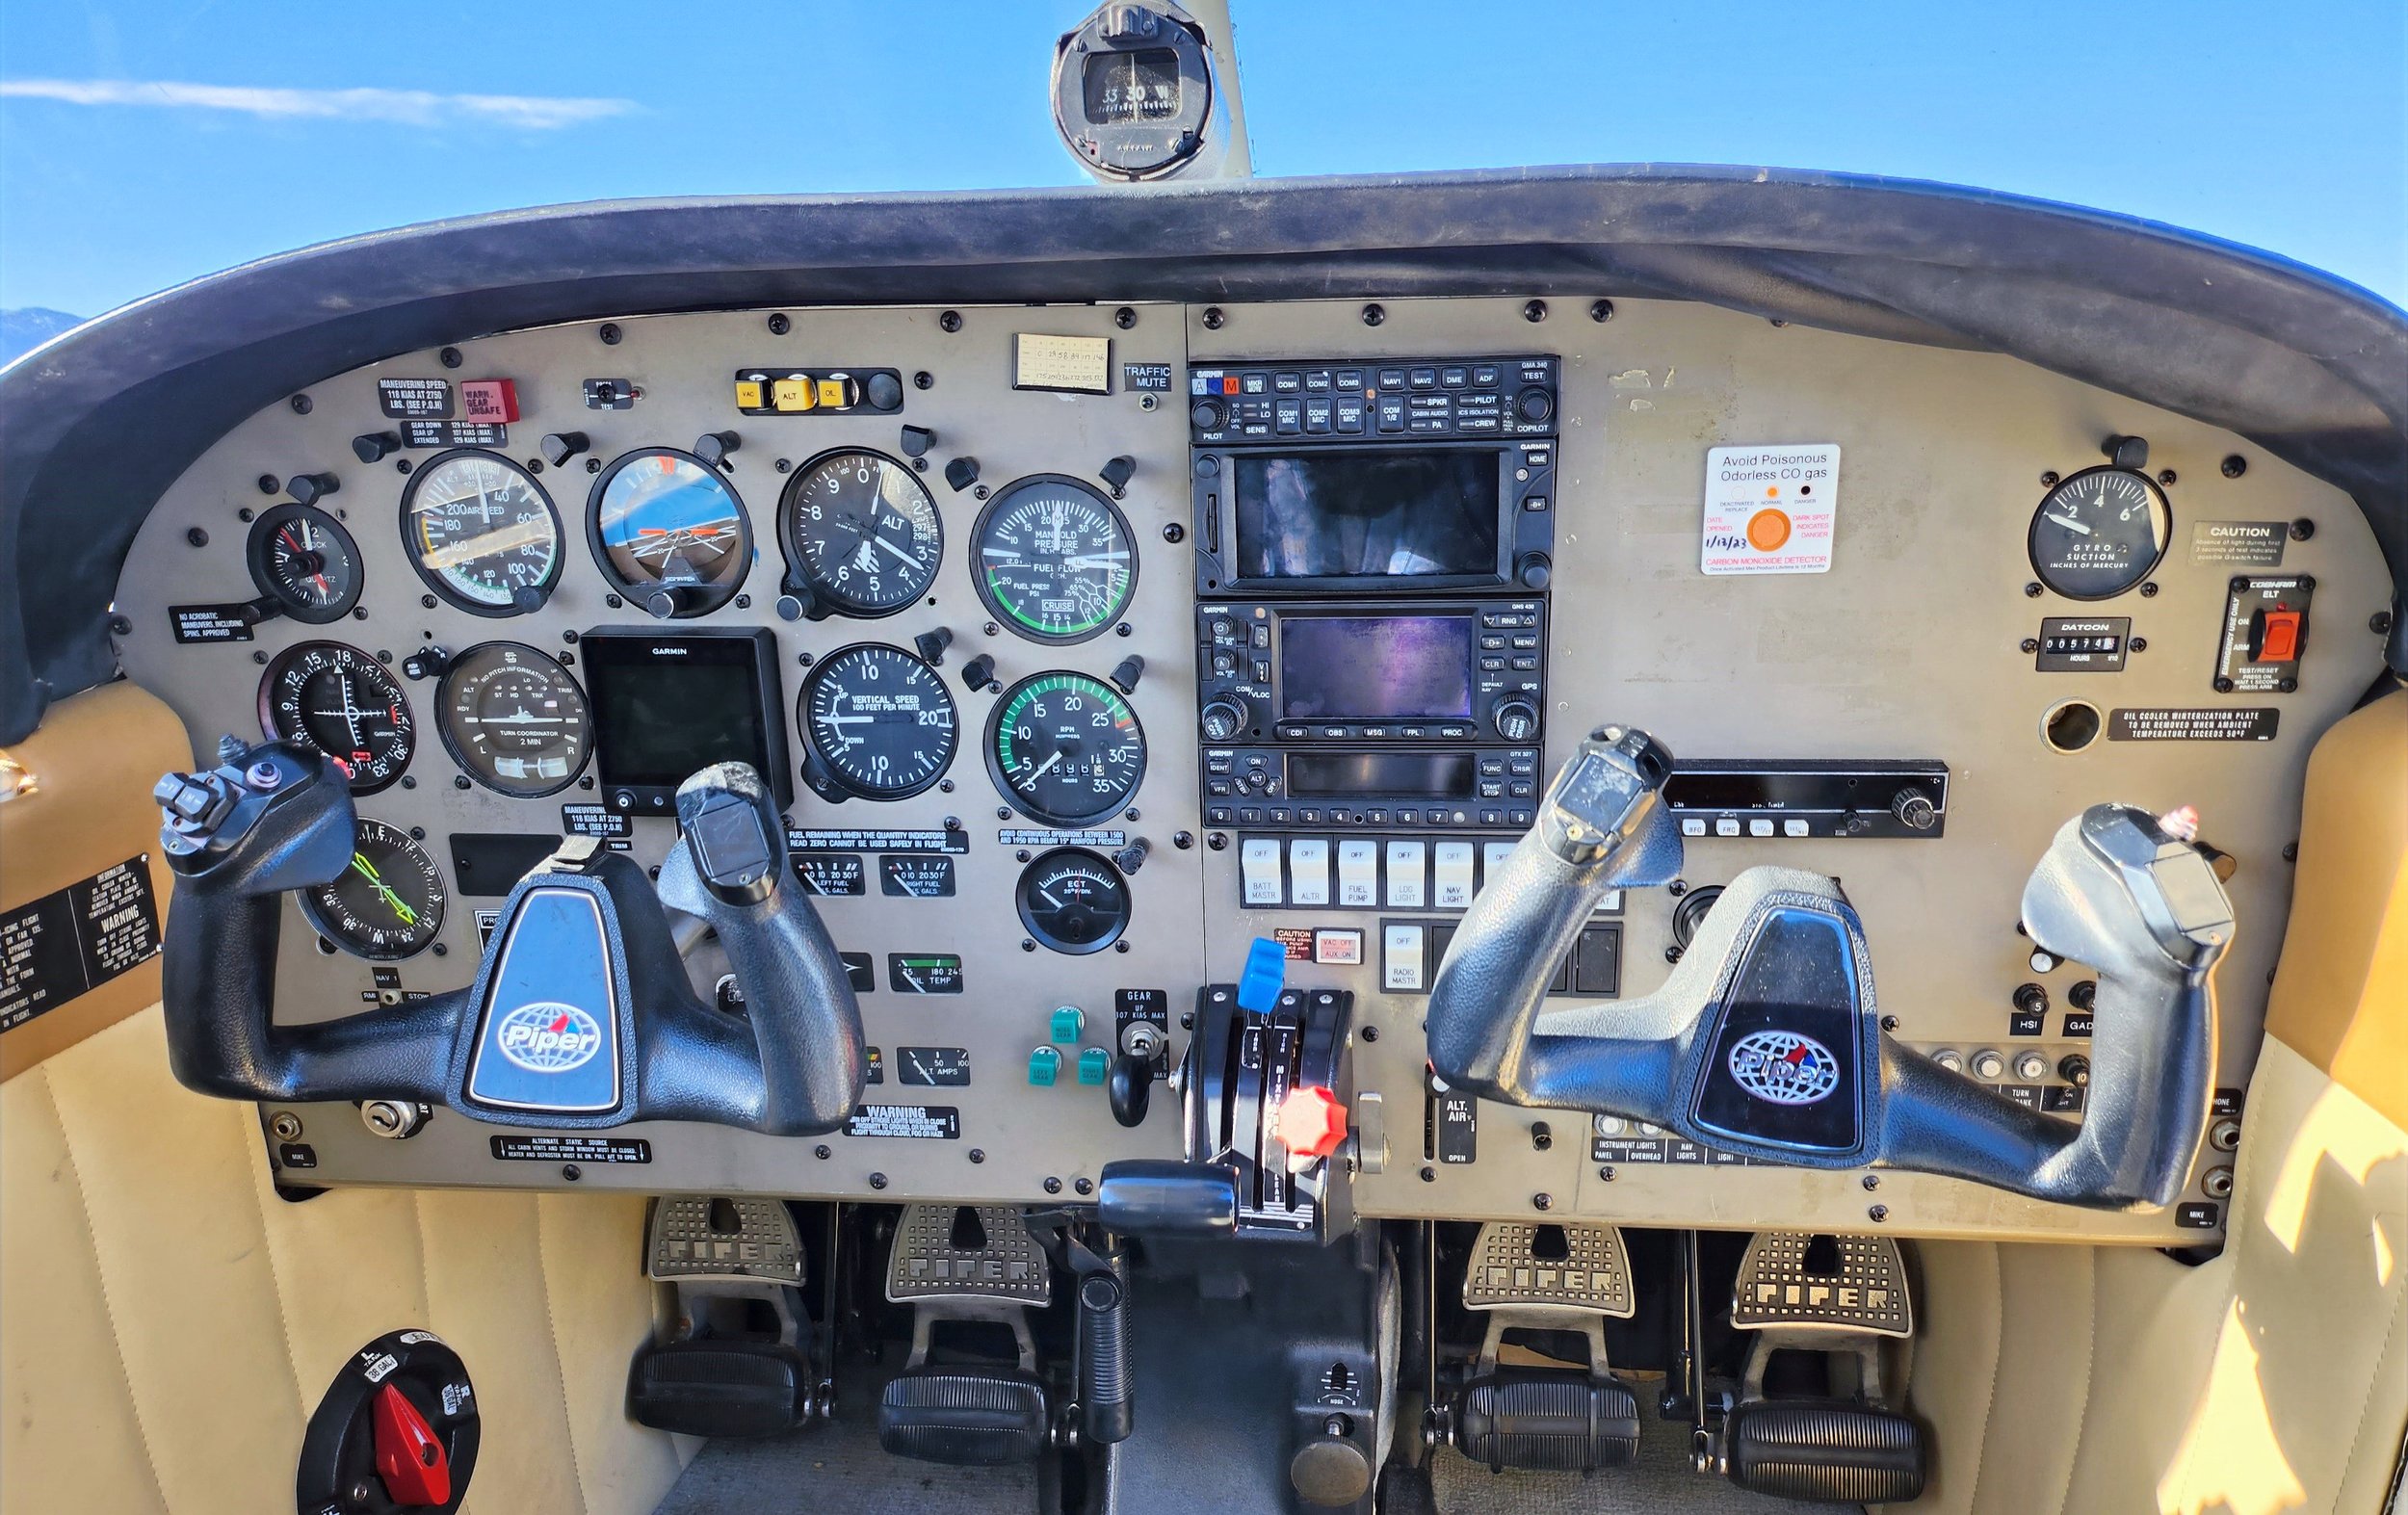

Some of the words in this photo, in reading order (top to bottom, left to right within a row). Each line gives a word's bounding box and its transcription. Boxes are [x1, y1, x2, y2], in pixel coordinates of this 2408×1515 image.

[1103, 89, 1118, 103] 33
[1155, 85, 1169, 99] W
[1125, 366, 1170, 378] TRAFFIC
[380, 380, 426, 389] MANEUVERING
[427, 380, 447, 389] SPEED
[1137, 378, 1166, 387] MUTE
[388, 390, 401, 399] 118
[402, 390, 416, 399] KIAS
[418, 390, 425, 399] AT
[427, 390, 443, 399] 2750
[391, 401, 406, 409] LBS.
[406, 400, 423, 410] (SEE
[470, 407, 502, 416] UNSAFE
[1722, 456, 1758, 466] Avoid
[1762, 454, 1827, 465] Poisonous
[1721, 470, 1777, 482] Odorless
[1781, 468, 1801, 479] CO
[1804, 470, 1827, 481] gas
[828, 479, 840, 494] 9
[495, 491, 510, 502] 40
[2093, 494, 2105, 508] 4
[811, 505, 823, 520] 8
[2068, 507, 2079, 519] 2
[2119, 509, 2131, 521] 6
[517, 513, 532, 524] 60
[882, 514, 905, 531] ALT
[2211, 527, 2270, 537] CAUTION
[1784, 556, 1827, 564] DETECTOR
[2066, 553, 2115, 562] SUCTION
[509, 563, 526, 574] 100
[1043, 601, 1073, 610] CRUISE
[2061, 623, 2110, 632] DATCON
[652, 647, 688, 656] GARMIN
[851, 695, 890, 704] VERTICAL
[895, 695, 920, 704] SPEED
[1064, 696, 1083, 712] 20
[918, 711, 938, 725] 20
[1092, 713, 1110, 727] 25
[2124, 712, 2136, 720] OIL
[2139, 712, 2168, 720] COOLER
[2171, 712, 2232, 720] WINTERIZATION
[2236, 712, 2259, 720] PLATE
[2129, 720, 2137, 729] TO
[2140, 720, 2150, 729] BE
[2154, 720, 2189, 729] REMOVED
[2192, 720, 2213, 729] WHEN
[2217, 720, 2252, 729] AMBIENT
[100, 903, 140, 933] WARNING
[1127, 991, 1152, 1001] GEAR
[2035, 1003, 2042, 1012] 5
[2020, 1021, 2038, 1030] HSI
[507, 1025, 596, 1055] Piper
[1736, 1051, 1836, 1087] Piper
[2078, 1073, 2087, 1082] 10
[1447, 1100, 1468, 1111] ALT.
[867, 1106, 927, 1119] WARNING
[1448, 1111, 1467, 1122] AIR
[1599, 1140, 1636, 1150] INSTRUMENT
[1636, 1141, 1657, 1150] LIGHTS
[1594, 1151, 1612, 1160] PANEL
[1631, 1152, 1662, 1161] OVERHEAD
[1676, 1152, 1697, 1161] LIGHTS
[2187, 1211, 2204, 1219] MIKE
[668, 1240, 782, 1260] PIPER
[908, 1258, 1029, 1281] PIPER
[1487, 1267, 1612, 1291] PIPER
[1756, 1283, 1887, 1309] PIPER
